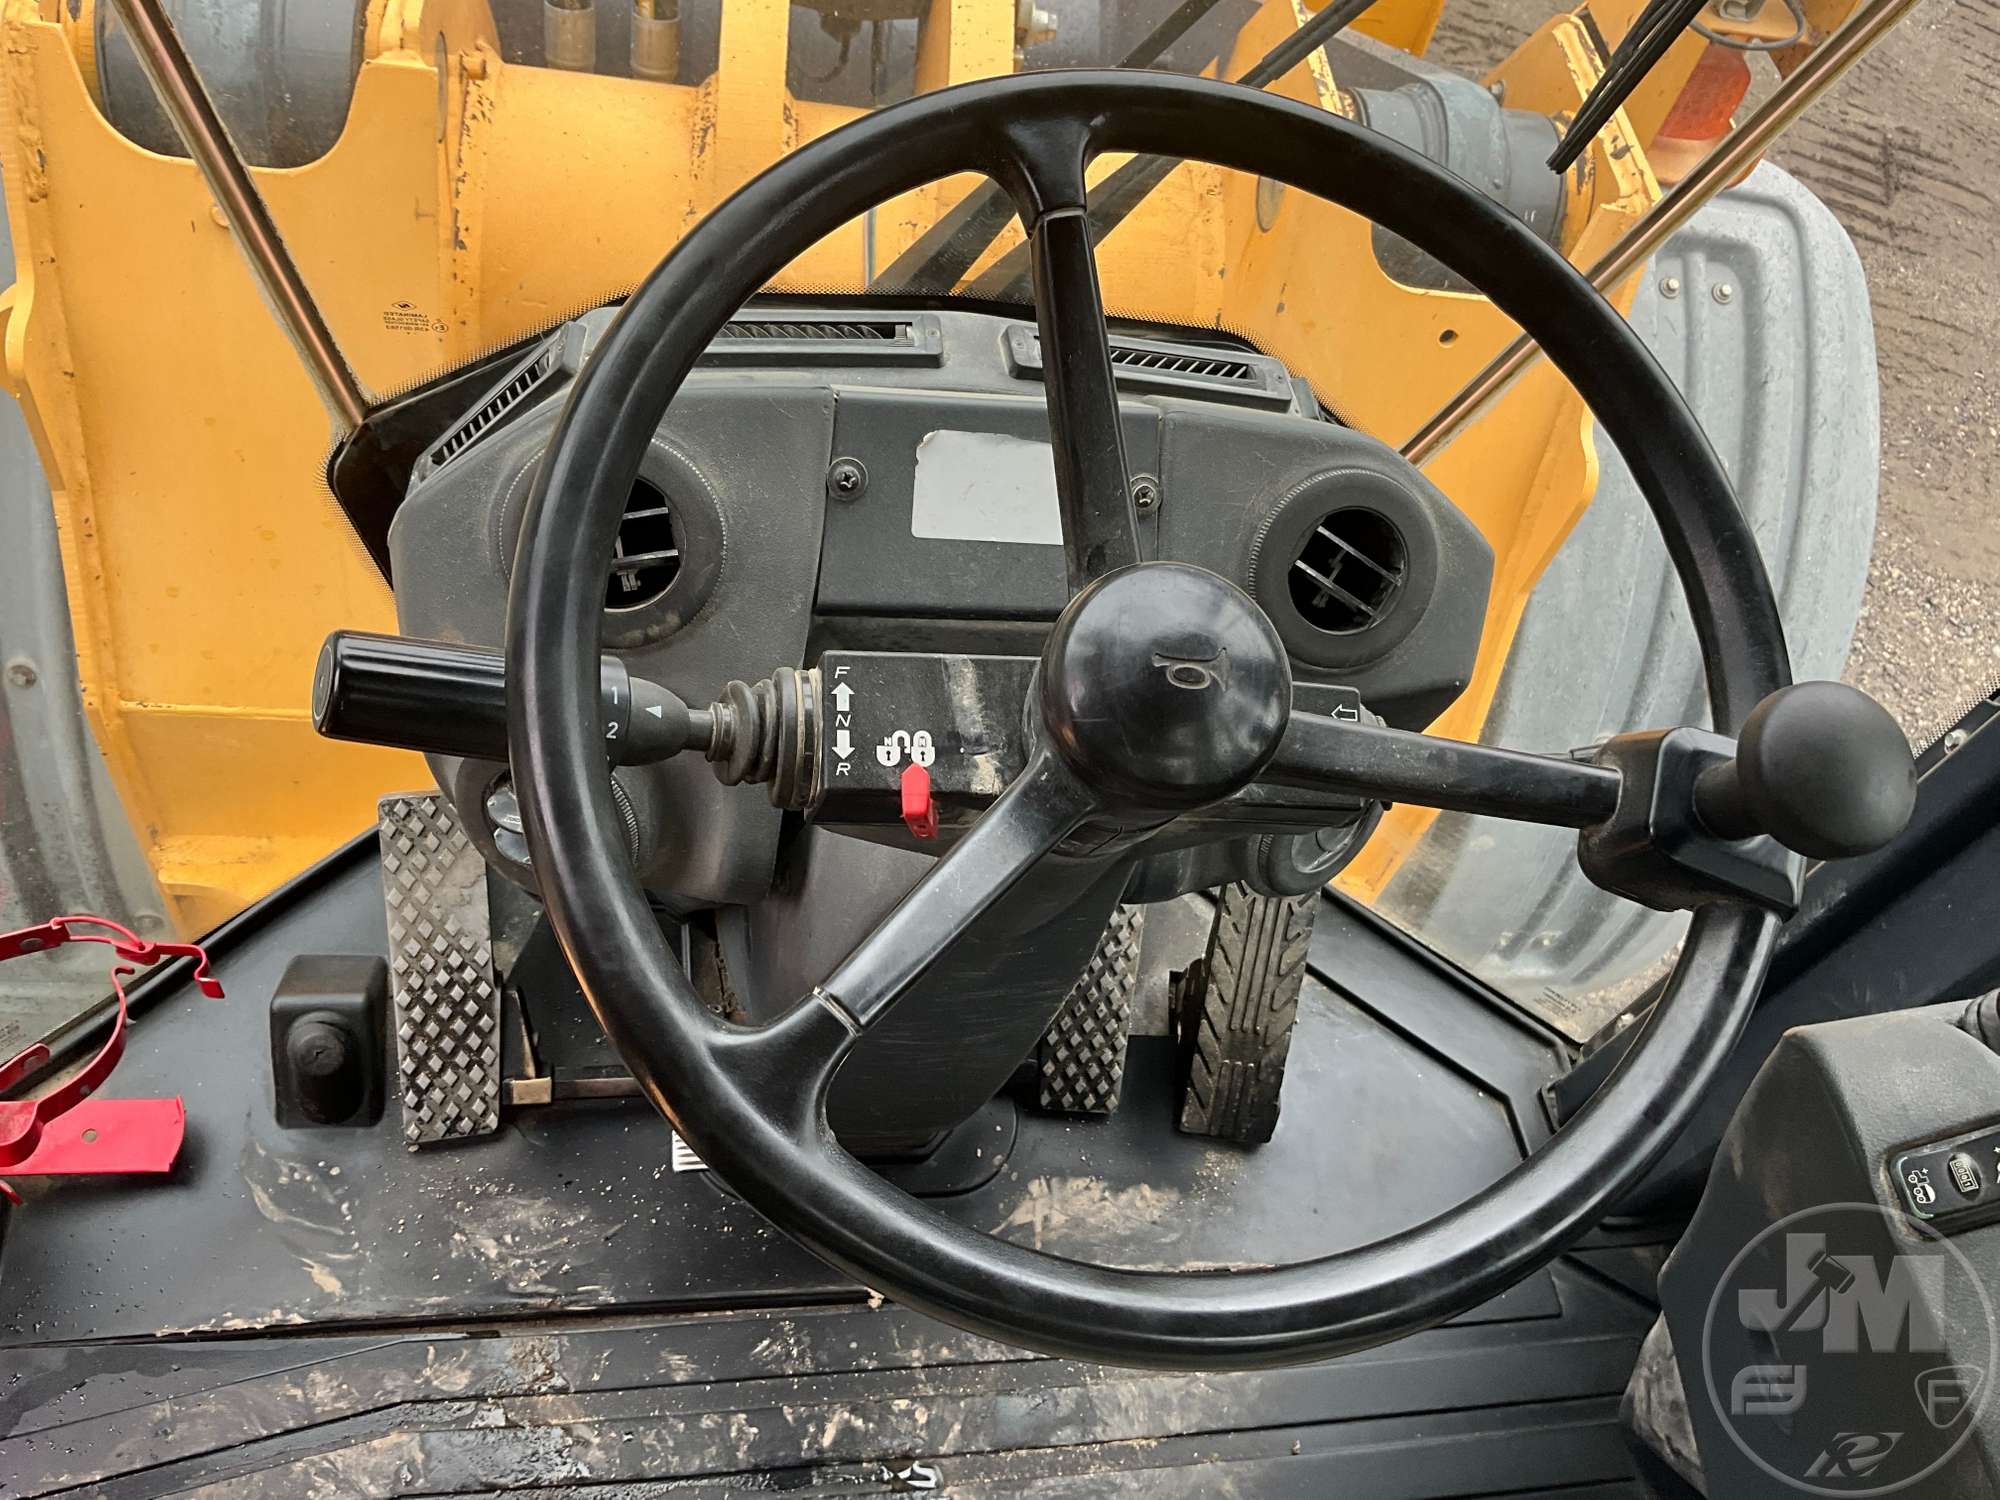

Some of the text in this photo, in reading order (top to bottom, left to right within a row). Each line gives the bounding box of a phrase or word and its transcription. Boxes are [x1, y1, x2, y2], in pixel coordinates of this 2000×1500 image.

[834, 666, 851, 679] F
[611, 686, 618, 705] 1
[835, 713, 851, 727] N
[605, 721, 619, 739] 2
[835, 762, 851, 776] R
